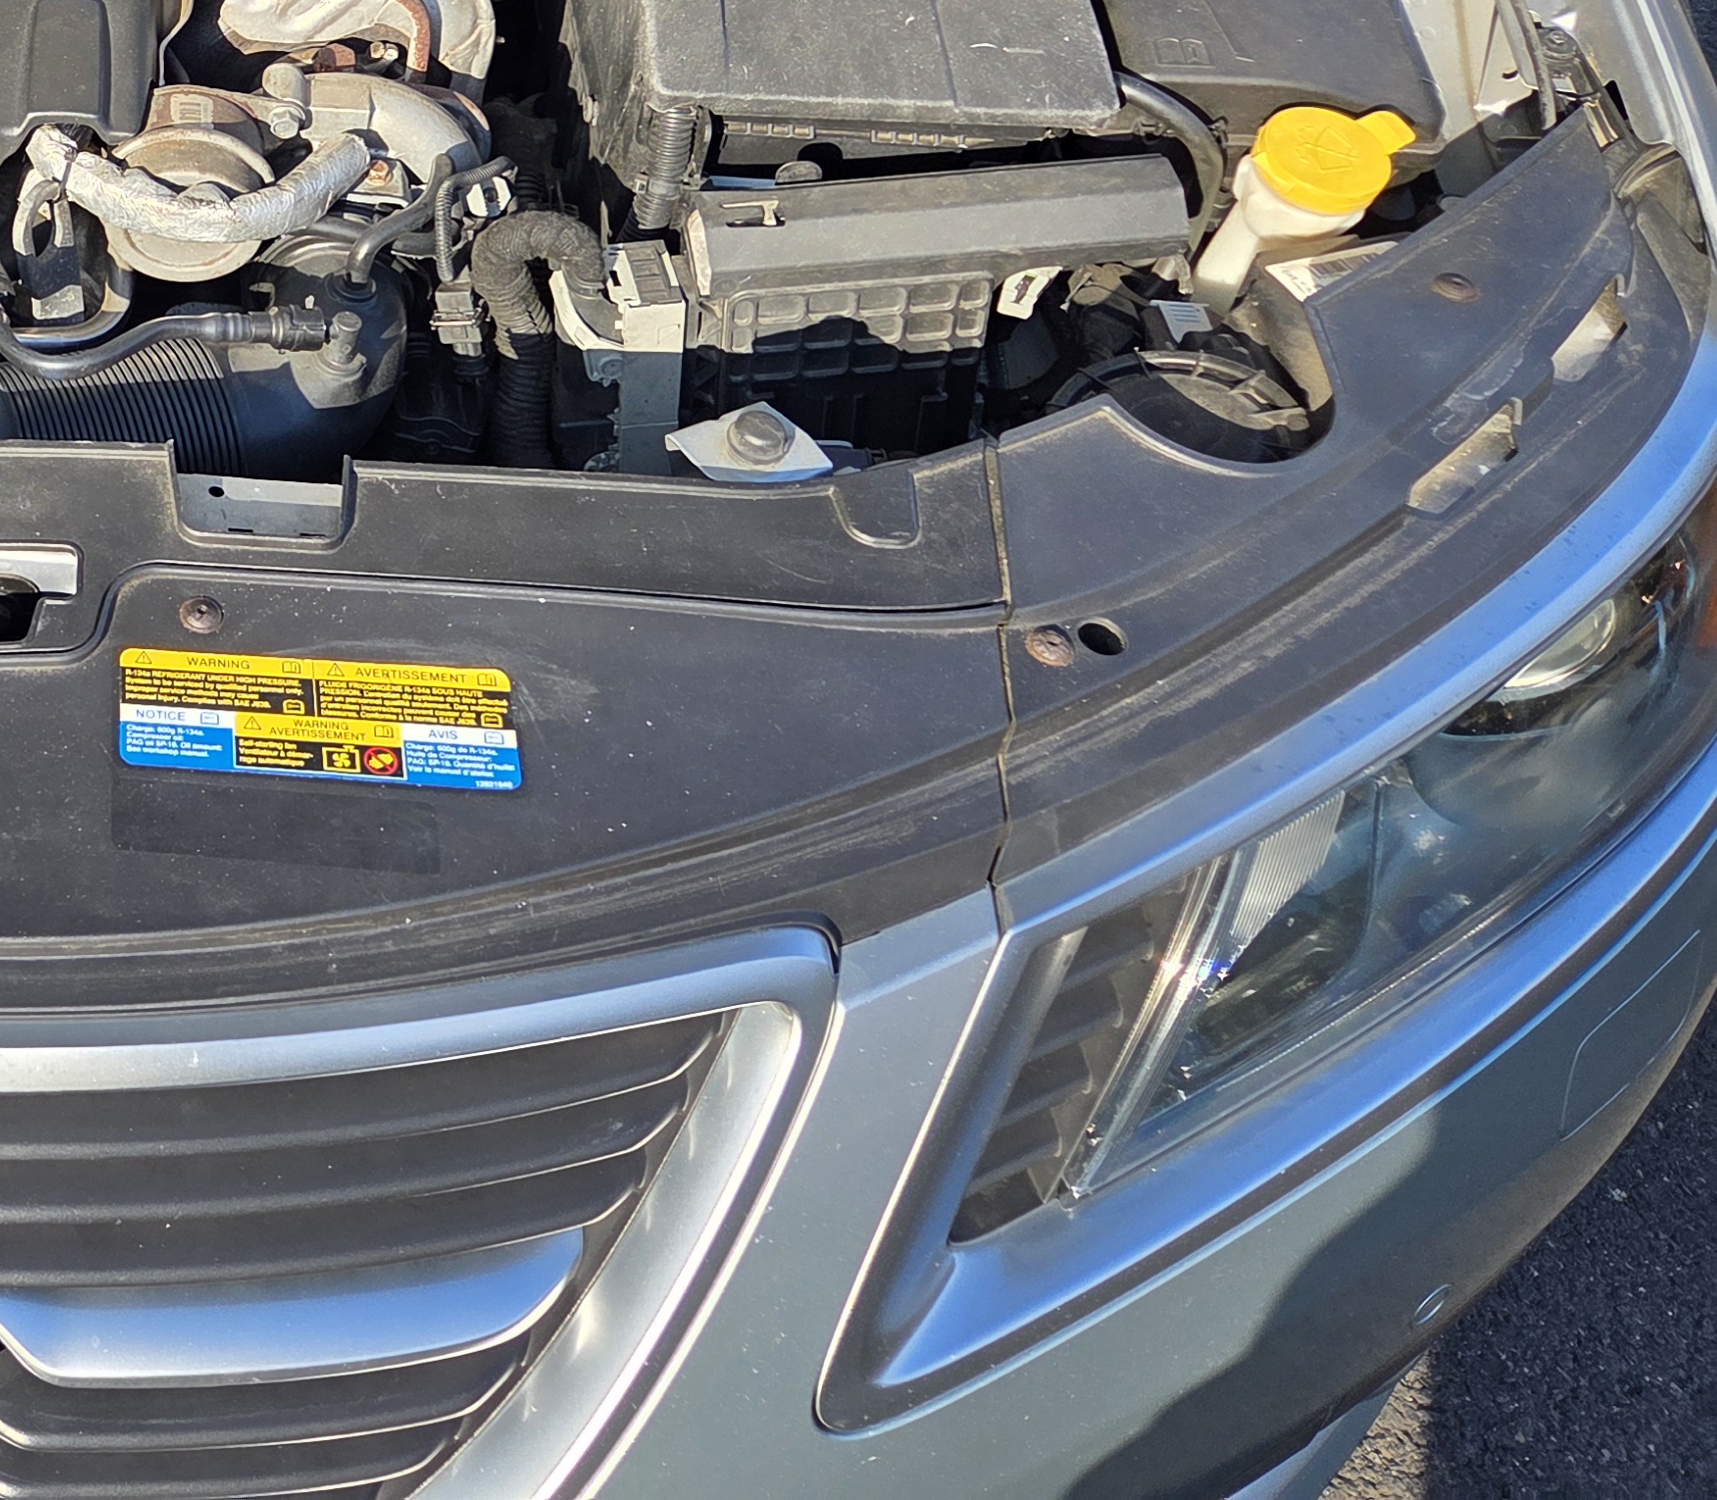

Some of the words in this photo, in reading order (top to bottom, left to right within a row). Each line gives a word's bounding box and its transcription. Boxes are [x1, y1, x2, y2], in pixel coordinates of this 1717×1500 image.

[187, 657, 250, 669] WARNING
[207, 674, 234, 682] UNDER
[355, 667, 466, 683] AVERTISSEMENT
[136, 709, 185, 721] NOTICE
[293, 719, 348, 730] WARNING
[269, 726, 365, 740] AVERTISSEMENT
[428, 729, 457, 739] AVIS
